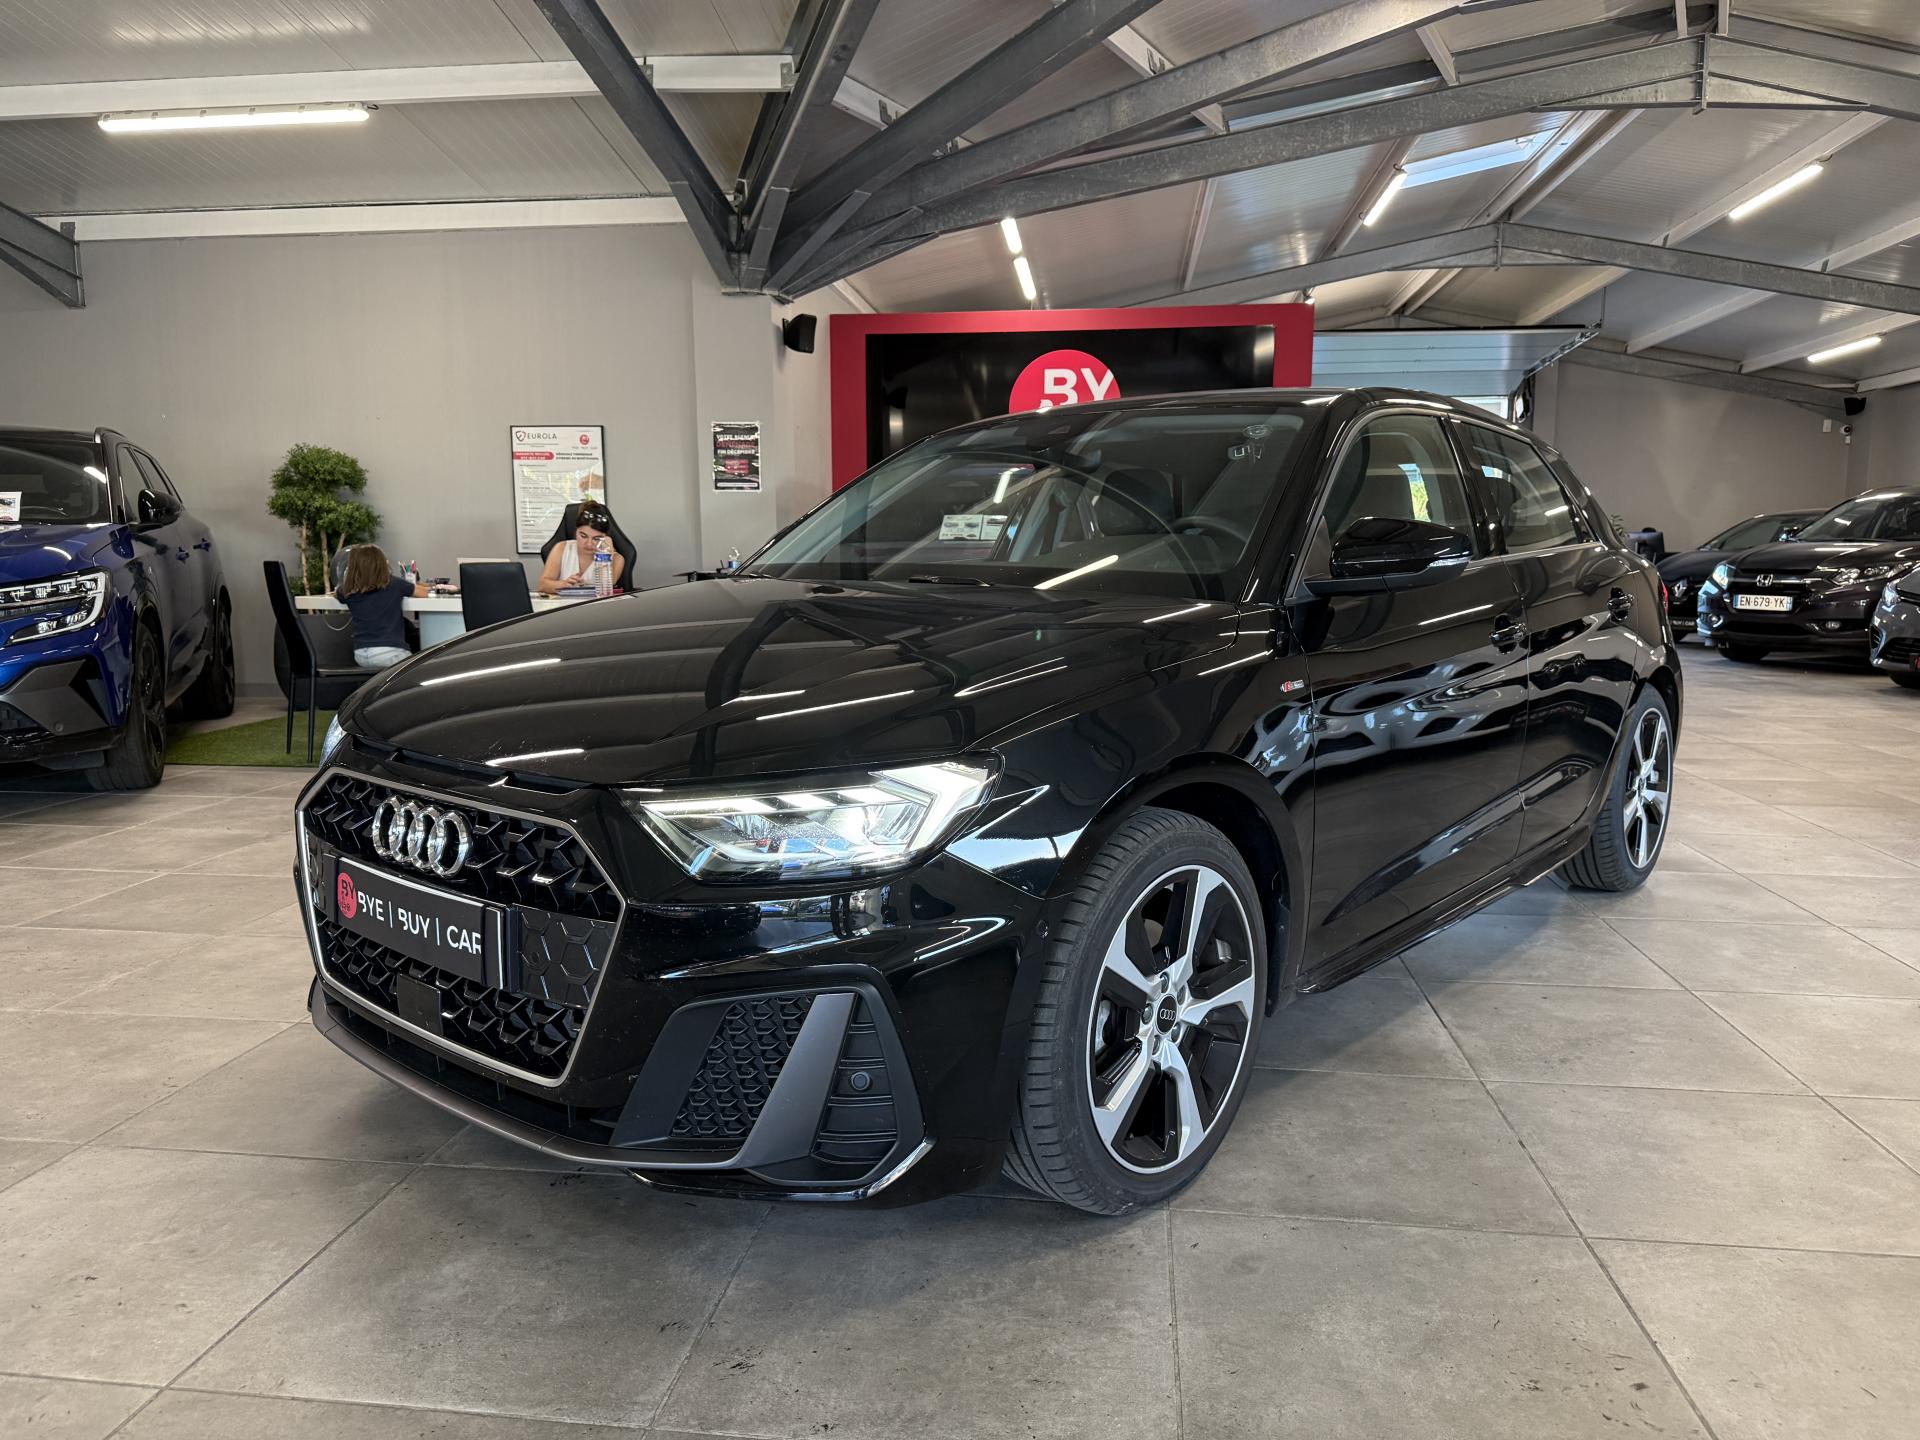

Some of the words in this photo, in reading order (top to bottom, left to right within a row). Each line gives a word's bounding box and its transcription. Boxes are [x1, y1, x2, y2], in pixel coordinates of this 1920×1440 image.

[1044, 367, 1114, 406] BY
[358, 890, 385, 922] BYE
[398, 907, 430, 939] BUY
[446, 925, 482, 955] CAR
